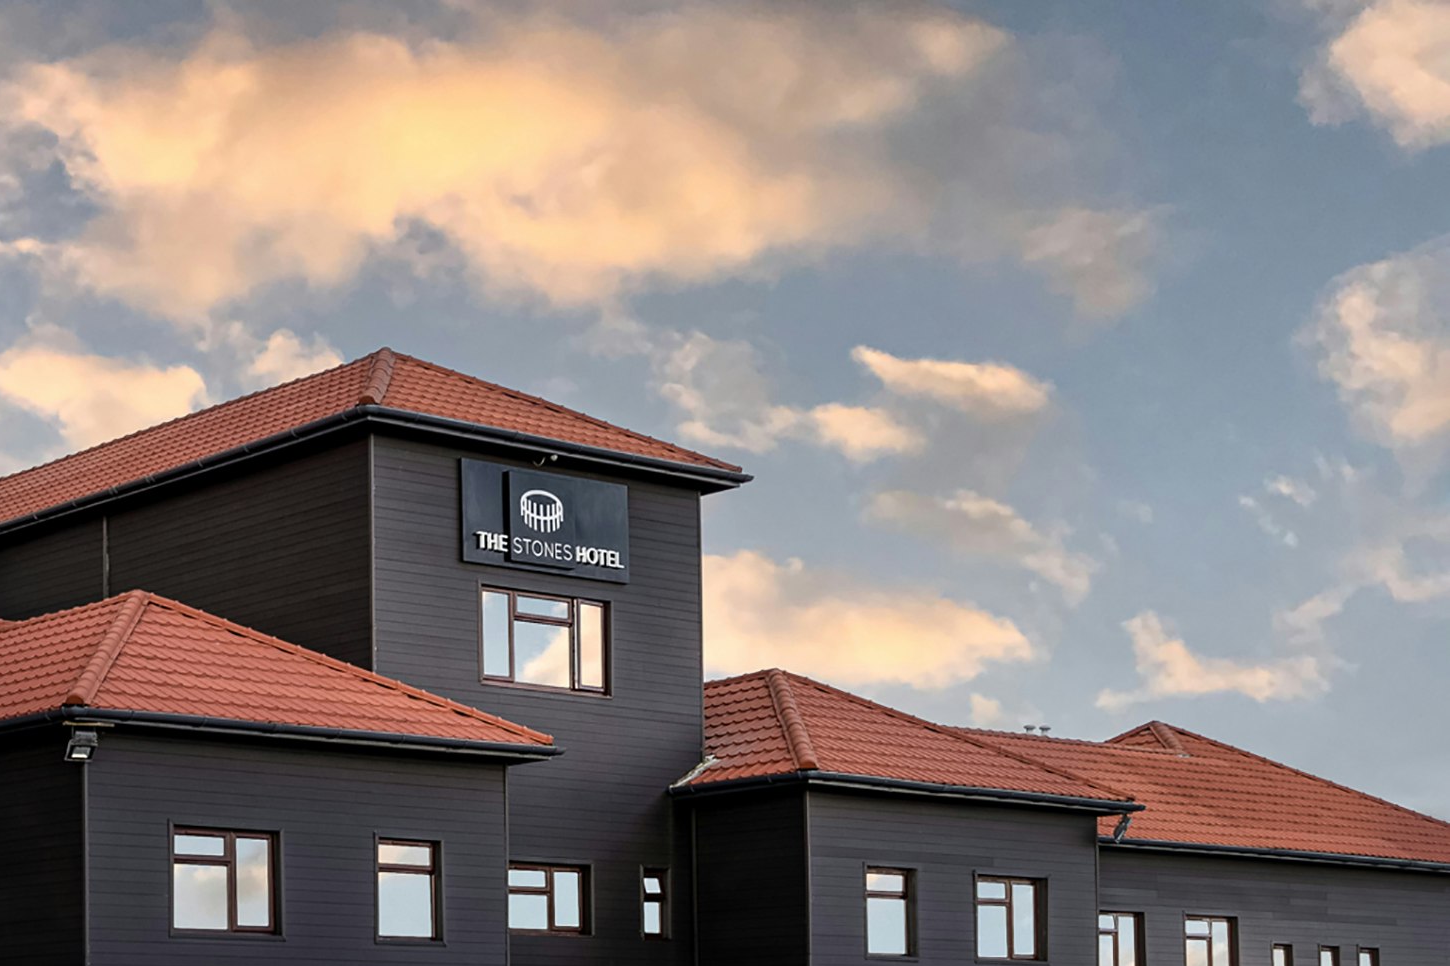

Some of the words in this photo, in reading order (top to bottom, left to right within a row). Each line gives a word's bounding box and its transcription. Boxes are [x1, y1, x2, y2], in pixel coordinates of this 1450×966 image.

[476, 530, 508, 552] THE
[513, 537, 572, 561] STONES
[575, 545, 625, 569] HOTEL
